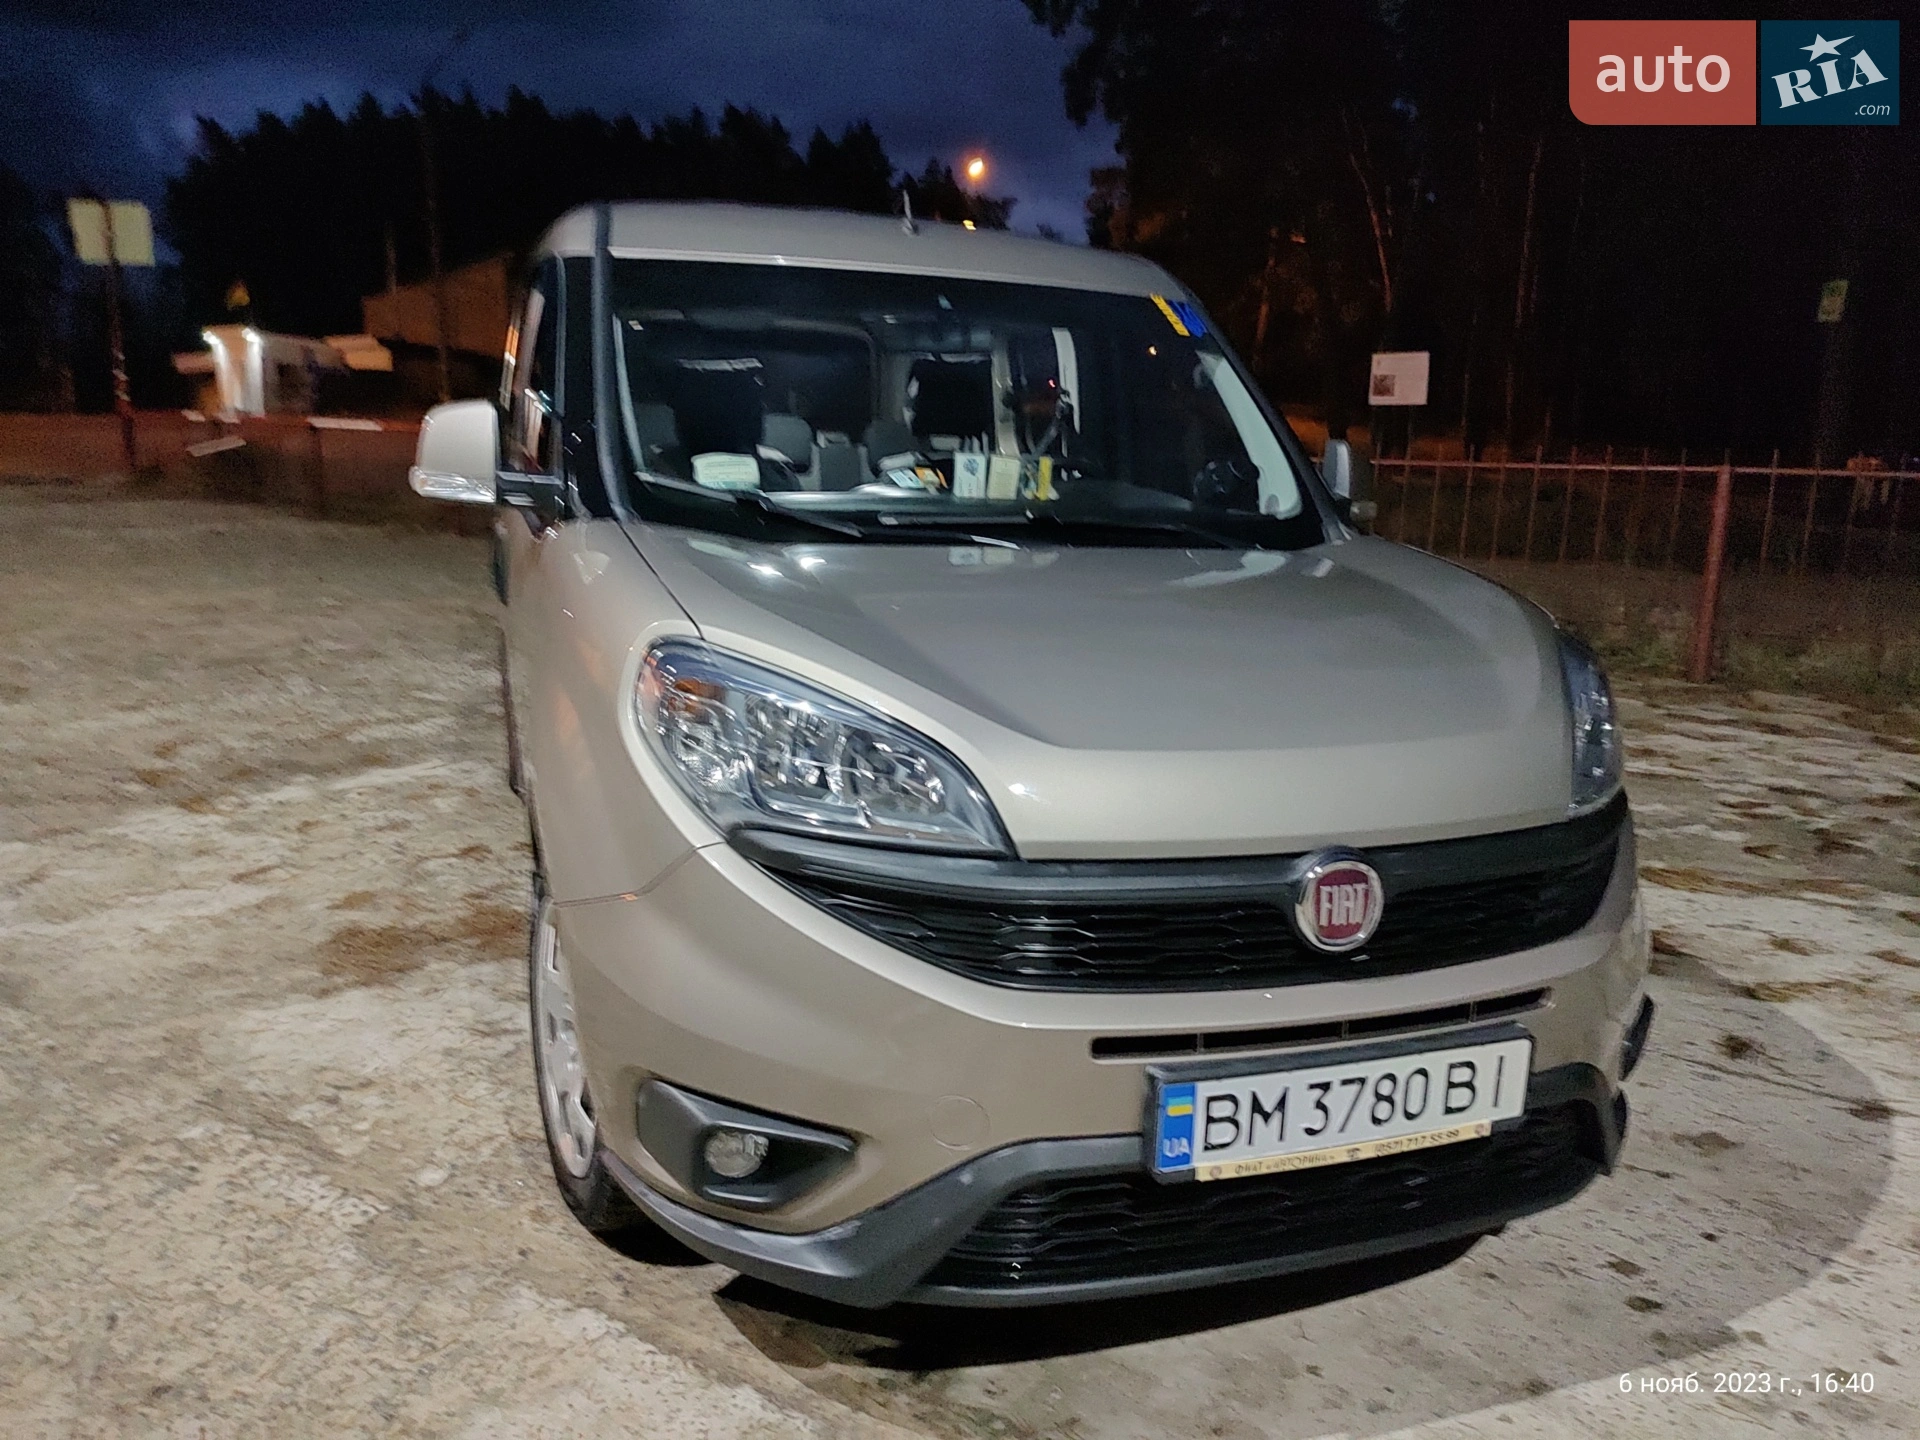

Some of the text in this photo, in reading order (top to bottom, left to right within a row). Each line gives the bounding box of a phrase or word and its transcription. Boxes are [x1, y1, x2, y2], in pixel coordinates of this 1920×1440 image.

[1319, 883, 1368, 927] FIAT
[1203, 1086, 1290, 1153] BM
[1303, 1067, 1429, 1136] 3780
[1163, 1136, 1190, 1158] UA
